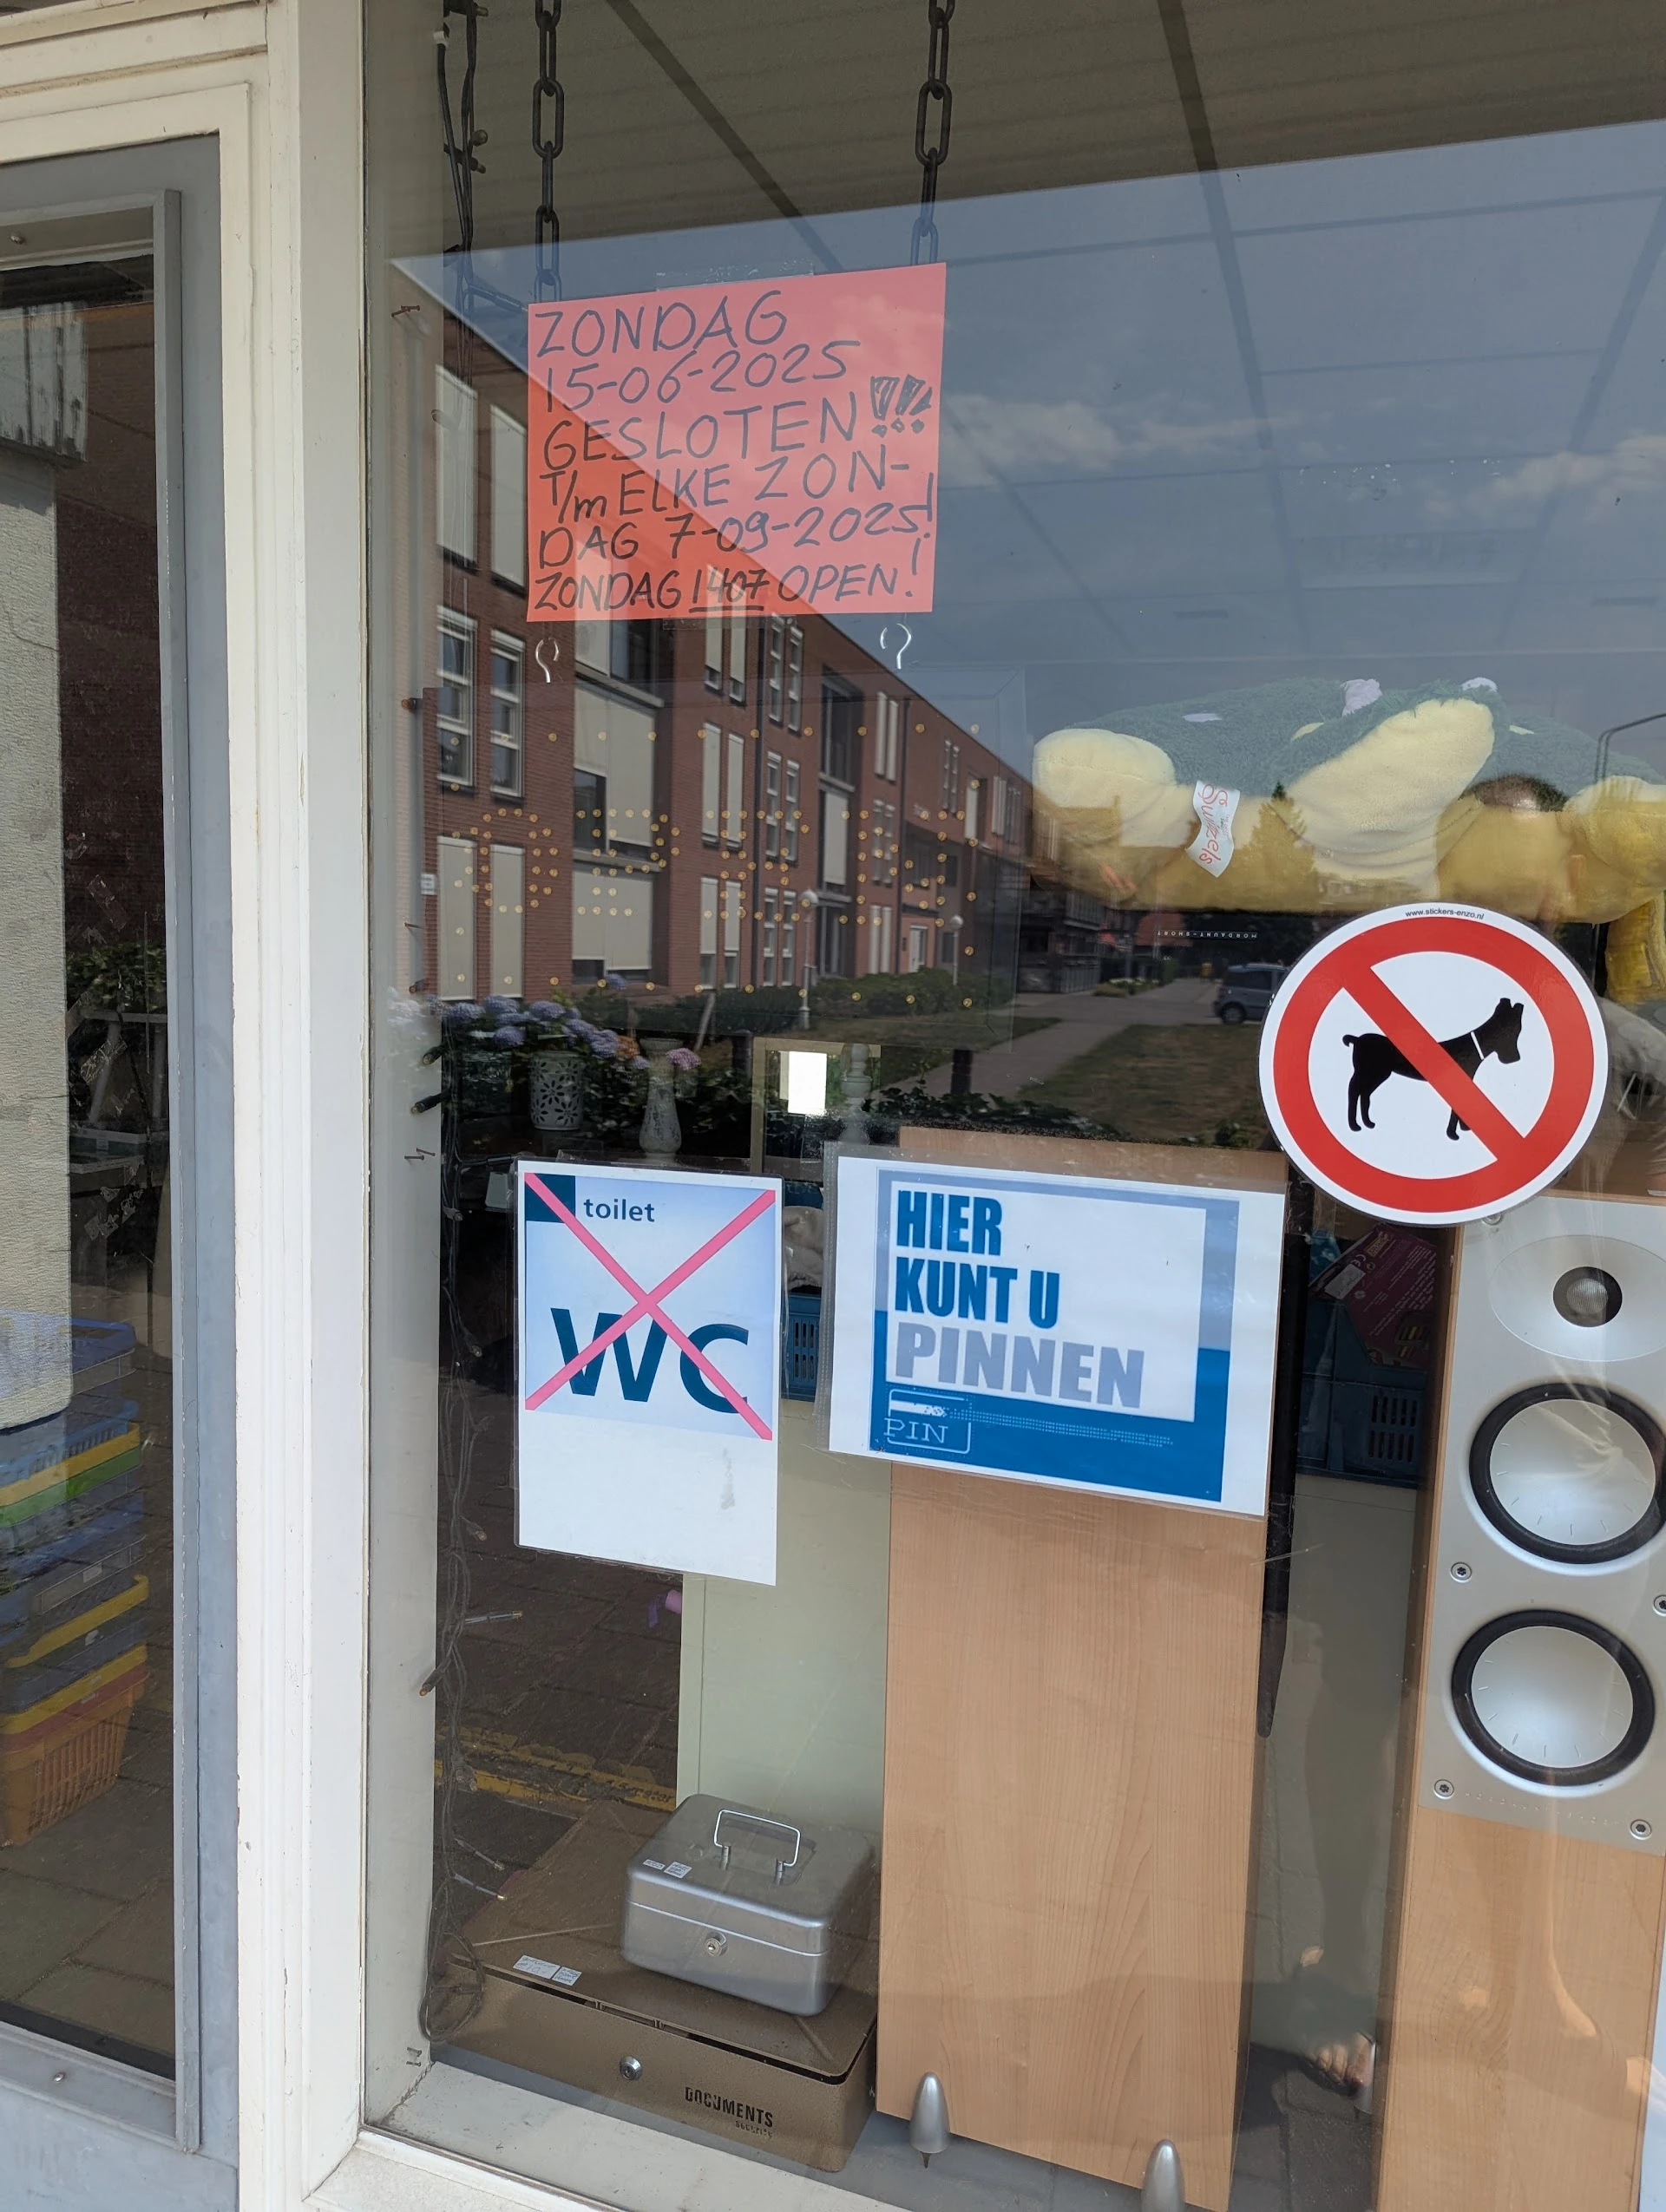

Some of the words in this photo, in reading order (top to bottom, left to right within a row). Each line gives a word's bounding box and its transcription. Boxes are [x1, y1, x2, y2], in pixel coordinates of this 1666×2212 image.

[535, 290, 788, 358] ZONDAG
[546, 340, 861, 413] 15-06-2025
[619, 462, 731, 518] ELKE
[539, 522, 640, 569] DAG
[534, 570, 683, 611] ZONDAG
[1405, 907, 1485, 920] www.stickers-enzo.nl
[583, 1198, 656, 1223] toilet
[896, 1189, 1003, 1256] HIER
[894, 1257, 1018, 1324] KUNT
[1028, 1270, 1060, 1329] U
[550, 1307, 749, 1415] WC
[895, 1321, 1145, 1410] PINNEN
[883, 1417, 949, 1444] PIN
[685, 2086, 773, 2128] DOCUMENTS
